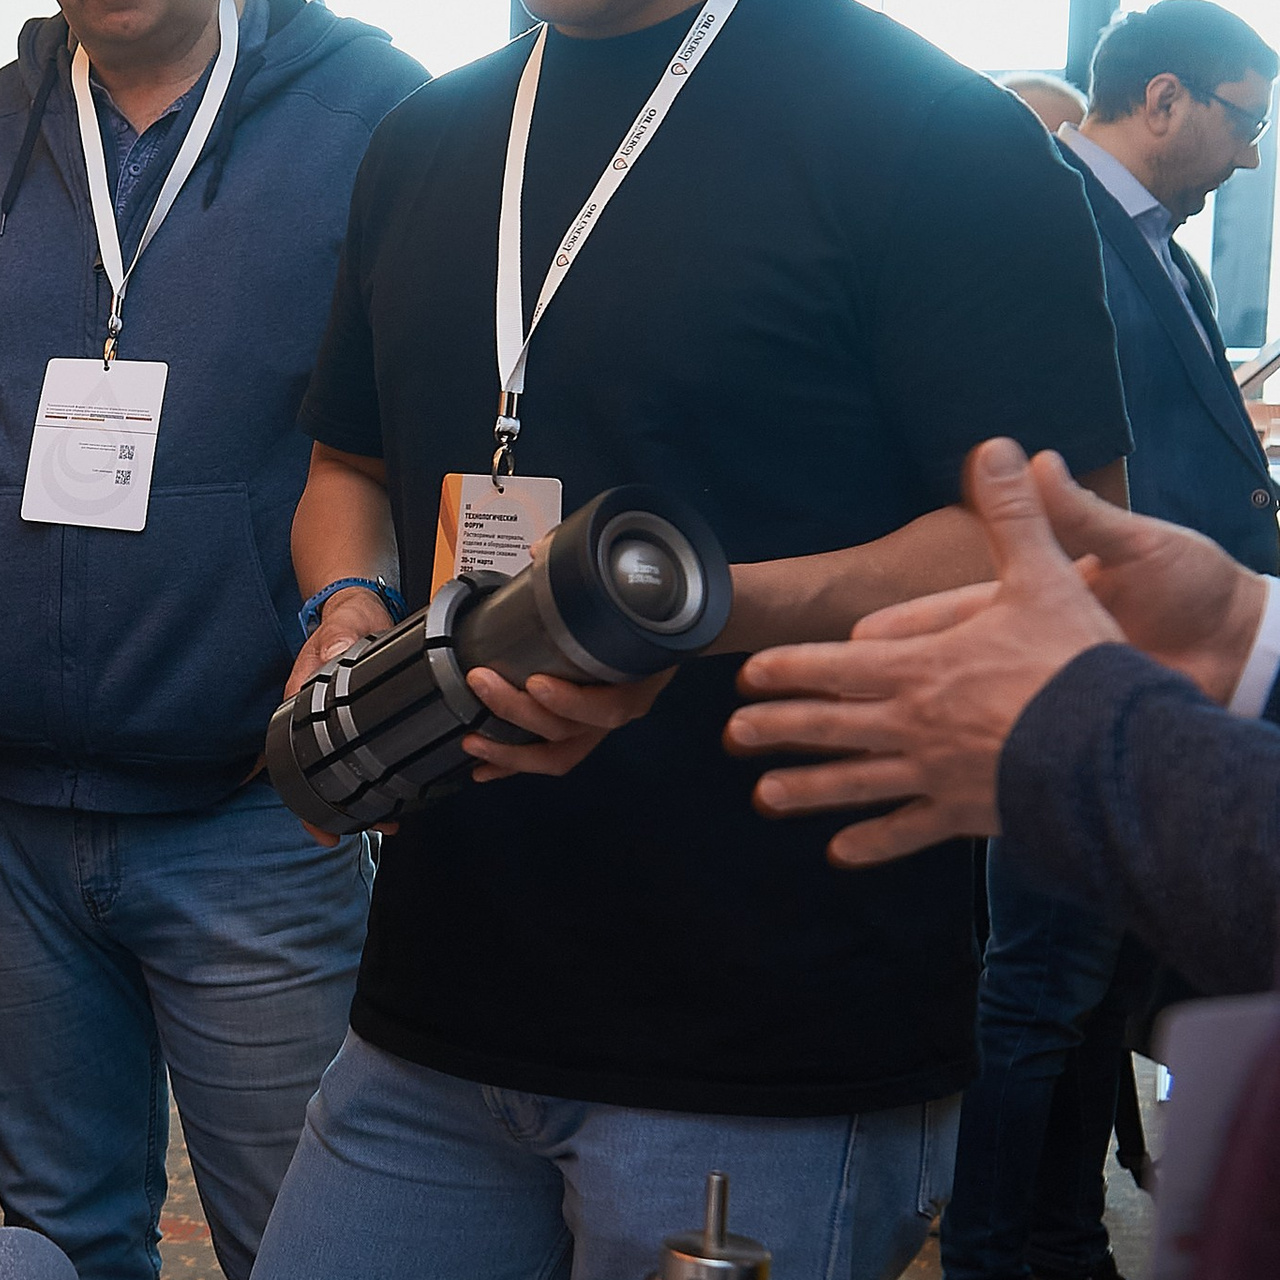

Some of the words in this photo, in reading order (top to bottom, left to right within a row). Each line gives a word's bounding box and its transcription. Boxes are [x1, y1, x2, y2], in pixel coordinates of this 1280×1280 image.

[701, 14, 716, 30] OIL
[678, 30, 706, 63] ENERGY
[641, 108, 657, 125] OIL
[621, 125, 647, 156] ENERGY
[584, 203, 598, 219] OIL
[563, 220, 588, 252] ENERGY
[465, 512, 517, 522] ТЕХНОЛОГИЧЕСКИЙ
